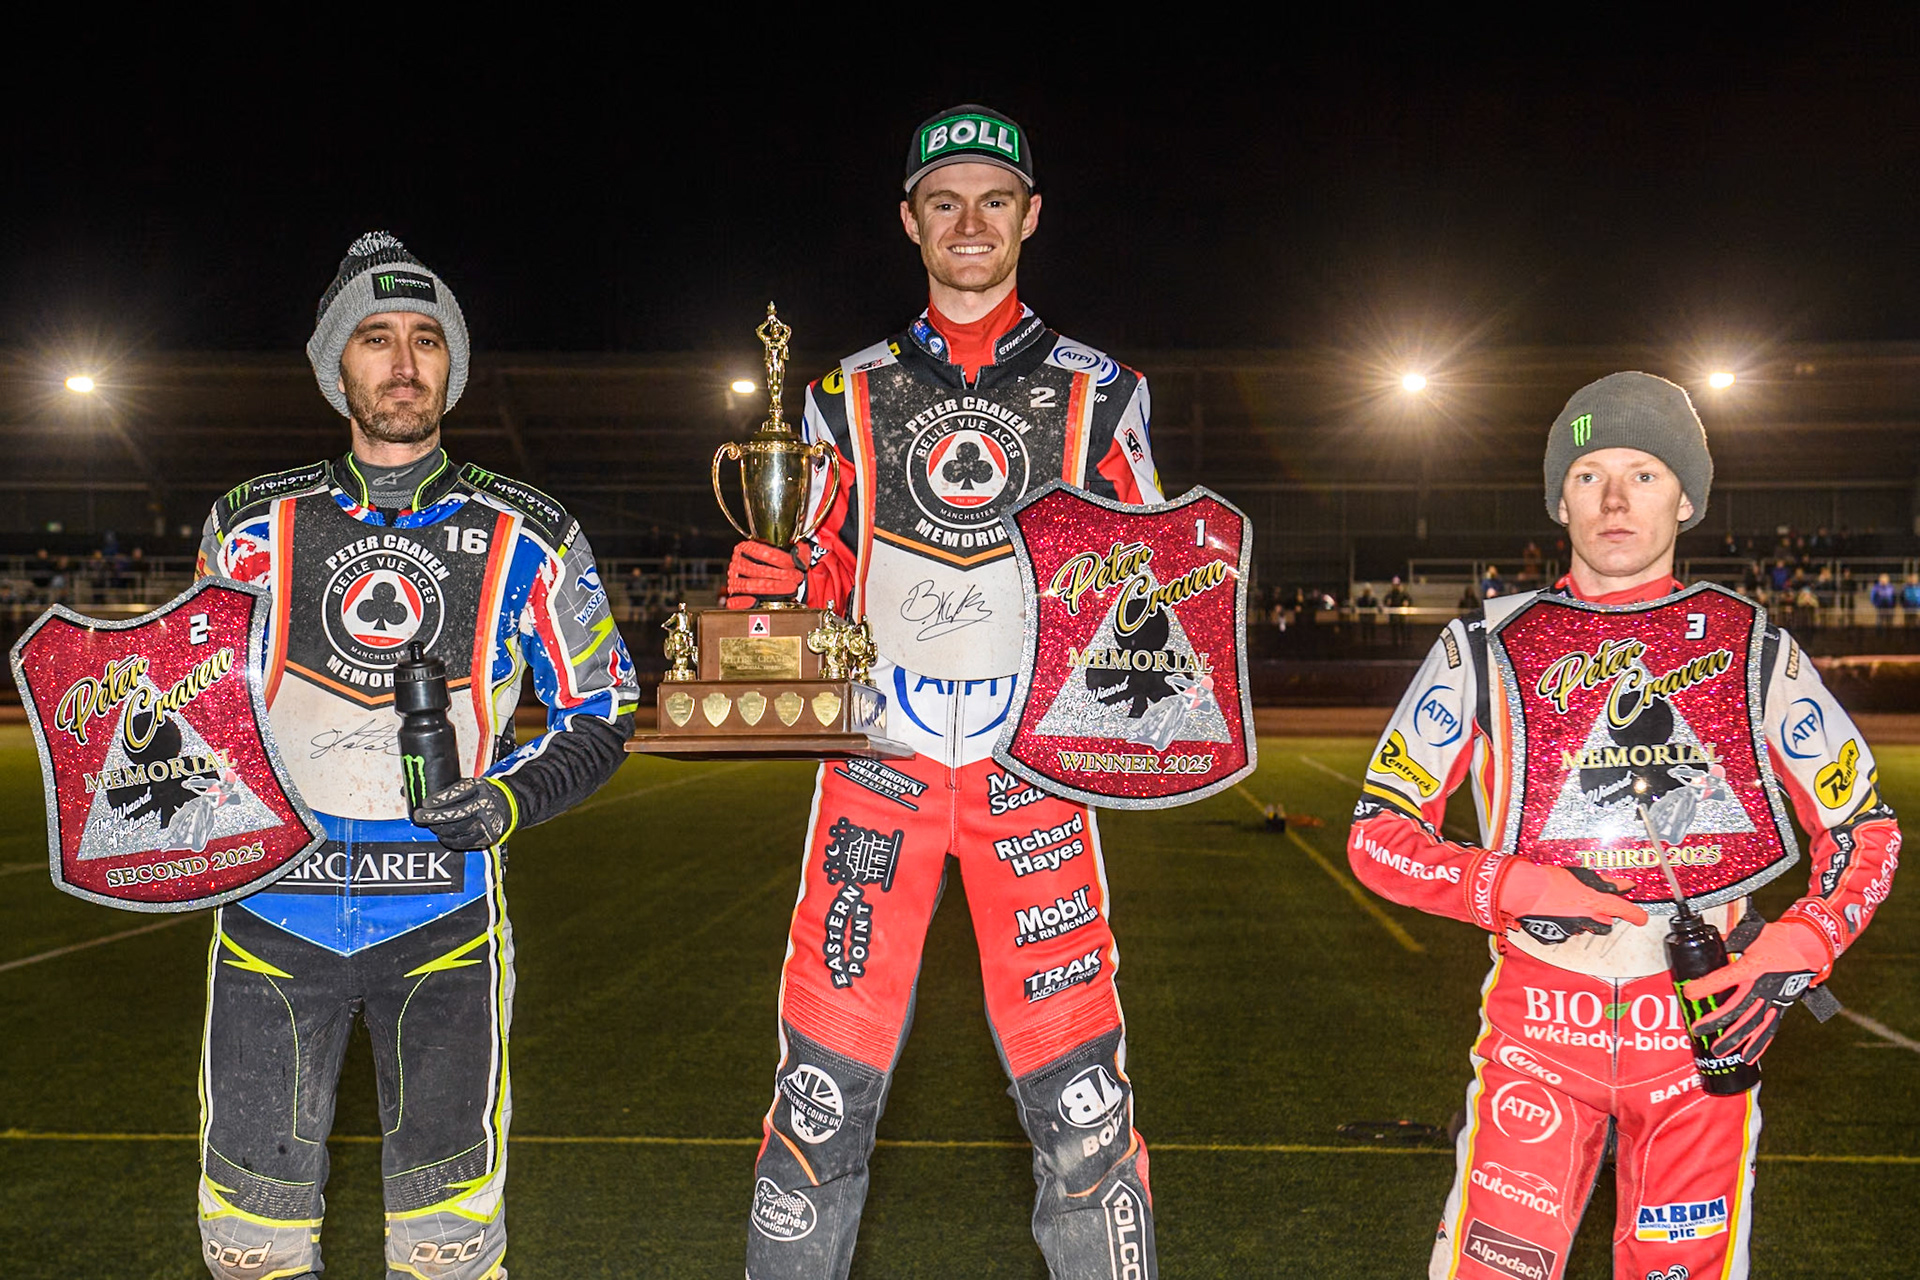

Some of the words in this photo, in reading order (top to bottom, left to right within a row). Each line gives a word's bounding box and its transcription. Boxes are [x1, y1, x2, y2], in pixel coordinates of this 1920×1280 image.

[927, 120, 1013, 153] BOLL
[1061, 351, 1092, 364] ATPI
[1030, 387, 1056, 408] 2
[905, 399, 958, 434] PETER
[963, 396, 1031, 435] CRAVEN
[916, 423, 951, 457] BELLE
[957, 418, 987, 430] VUE
[991, 428, 1020, 459] ACES
[252, 469, 322, 492] MONSTER
[493, 481, 561, 522] MONSTER
[940, 508, 996, 520] MANCHESTER
[444, 526, 488, 554] 16
[915, 518, 1008, 548] MEMORIA
[1195, 518, 1206, 547] 1
[325, 535, 379, 570] PETER
[383, 534, 450, 581] CRAVEN
[332, 560, 370, 595] BELLE
[376, 557, 407, 572] VUE
[410, 571, 436, 604] ACES
[1050, 541, 1153, 615] Peter
[1115, 559, 1228, 636] Craven
[189, 614, 209, 645] 2
[1685, 613, 1706, 639] 3
[351, 646, 406, 660] MANCHESTER
[1067, 647, 1214, 673] MEMORIAL
[326, 655, 395, 687] MEMOR
[1537, 638, 1646, 714] Peter
[56, 653, 149, 744] Peter
[122, 647, 234, 751] Craven
[1083, 675, 1129, 705] Wizard
[1608, 649, 1732, 730] Craven
[1422, 699, 1458, 734] ATPI
[83, 748, 238, 793] MEMORIAL
[1058, 751, 1161, 774] WINNER
[1163, 754, 1213, 774] 2025
[1381, 738, 1431, 792] Rentruck
[1561, 743, 1724, 770] MEMORIAL
[879, 769, 923, 796] BROWN
[112, 787, 152, 821] Wizard
[990, 787, 1045, 815] Sea
[995, 814, 1083, 860] Richard
[106, 856, 208, 887] SECOND
[211, 842, 265, 870] 2025
[285, 851, 451, 880] ARCAREK
[1012, 840, 1083, 876] Hayes
[1365, 839, 1461, 884] IMMERGAS
[1578, 849, 1661, 870] THIRD
[1667, 845, 1722, 866] 2025
[1016, 888, 1089, 935] Mobil
[827, 885, 860, 985] EASTERN
[849, 904, 869, 974] POINT
[1016, 937, 1024, 946] F
[1027, 934, 1037, 943] &
[1039, 928, 1057, 939] RN
[1026, 948, 1101, 991] TRAK
[1033, 965, 1100, 999] INDUSTRIES
[1523, 986, 1602, 1028] BIO
[1508, 1052, 1562, 1085] WIKO
[780, 1081, 808, 1112] CHALLENGE
[806, 1106, 829, 1124] COINS
[828, 1118, 840, 1127] UK
[1650, 1073, 1702, 1104] BATE
[1500, 1095, 1551, 1127] ATPI
[760, 1205, 808, 1230] Hughes
[1639, 1199, 1725, 1223] ALBON
[1470, 1240, 1543, 1279] Alpodach
